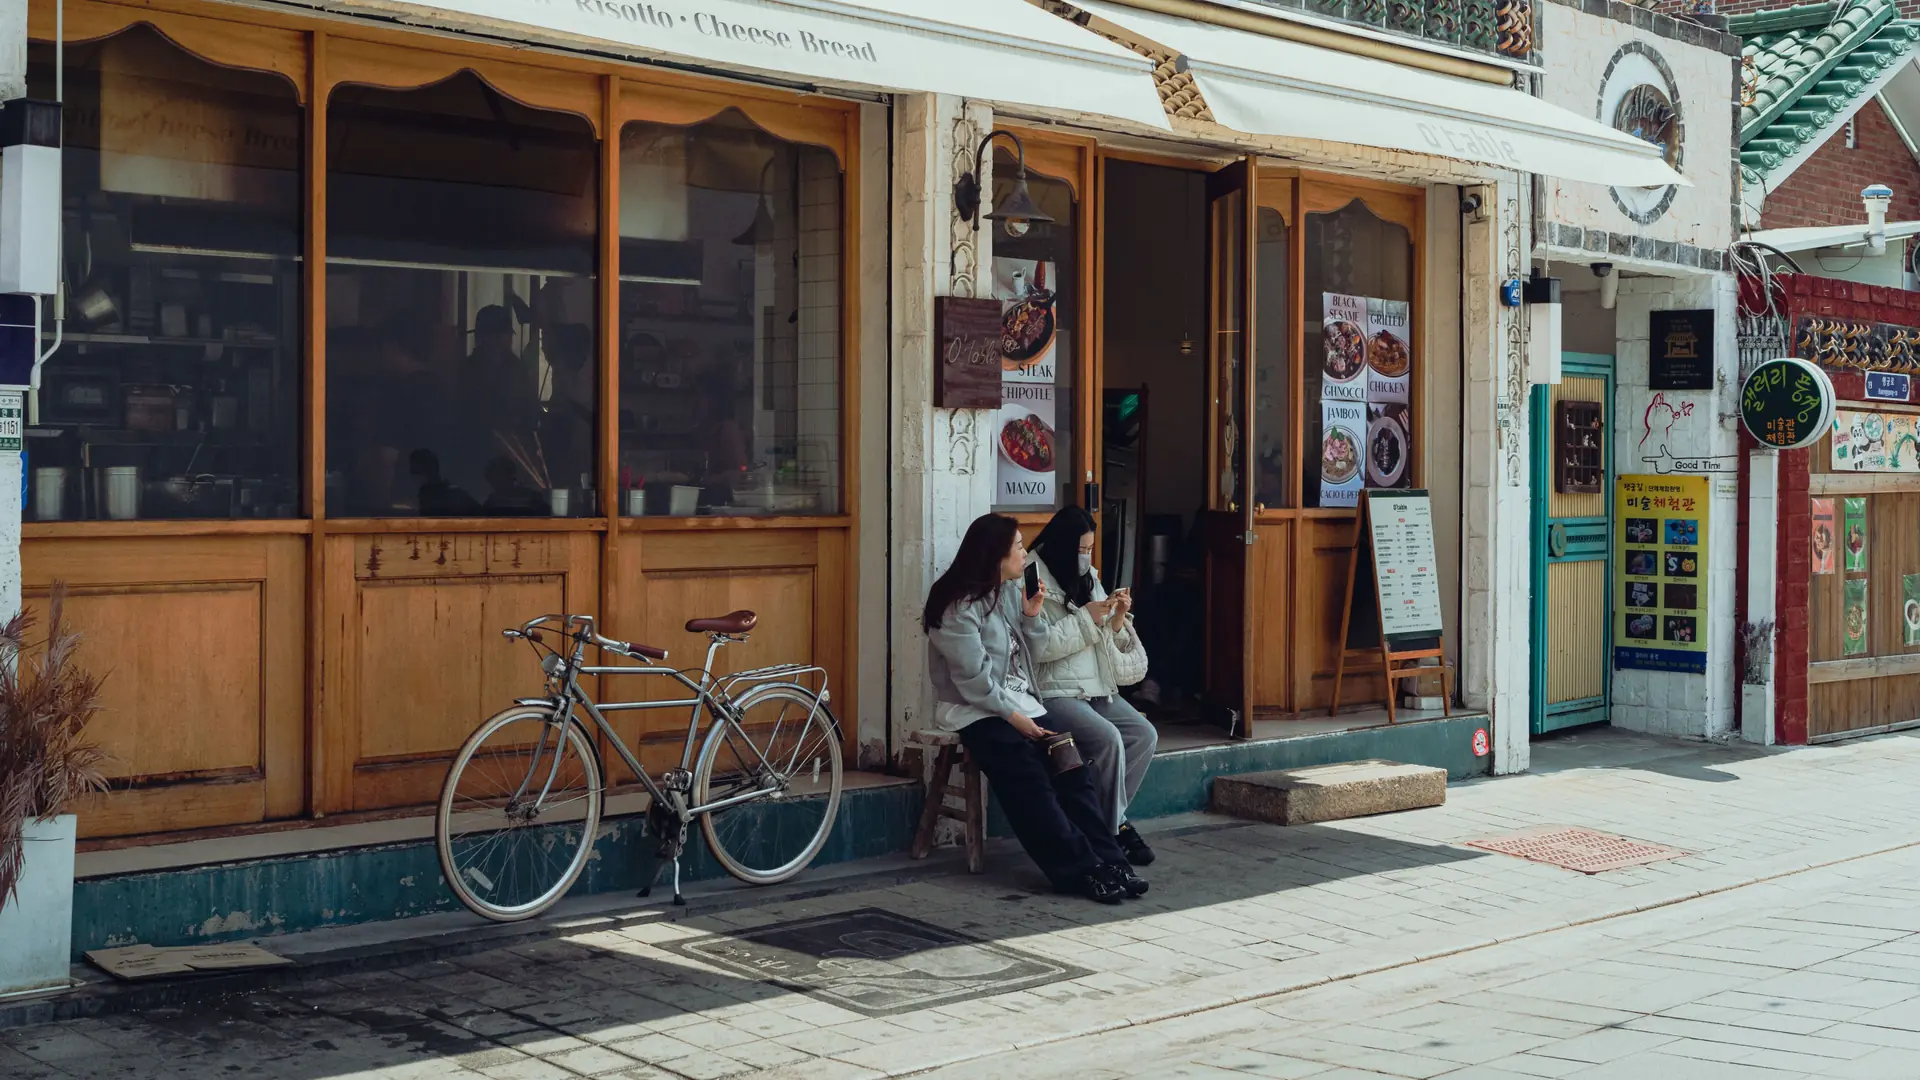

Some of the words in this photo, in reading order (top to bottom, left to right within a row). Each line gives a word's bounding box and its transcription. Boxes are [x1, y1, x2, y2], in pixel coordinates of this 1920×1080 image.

[694, 12, 792, 49] Cheese
[798, 29, 878, 63] Bread
[1332, 295, 1357, 308] BLACK
[1329, 308, 1360, 322] SESAME
[1370, 313, 1404, 327] GRILLED
[1018, 363, 1053, 378] STEAK
[1000, 386, 1052, 400] CHIPOTLE
[1324, 385, 1364, 399] GHNOCCI
[1369, 381, 1405, 394] CHICKEN
[1744, 364, 1787, 412] 갤러리
[1791, 373, 1820, 423] 풍경
[1327, 407, 1360, 420] JAMBON
[1767, 417, 1795, 431] 미술관
[1766, 432, 1796, 444] 체험관
[1675, 460, 1698, 470] Good
[1005, 481, 1046, 495] MANZO
[1320, 490, 1340, 499] CACIO
[1627, 496, 1695, 511] 미술체험관
